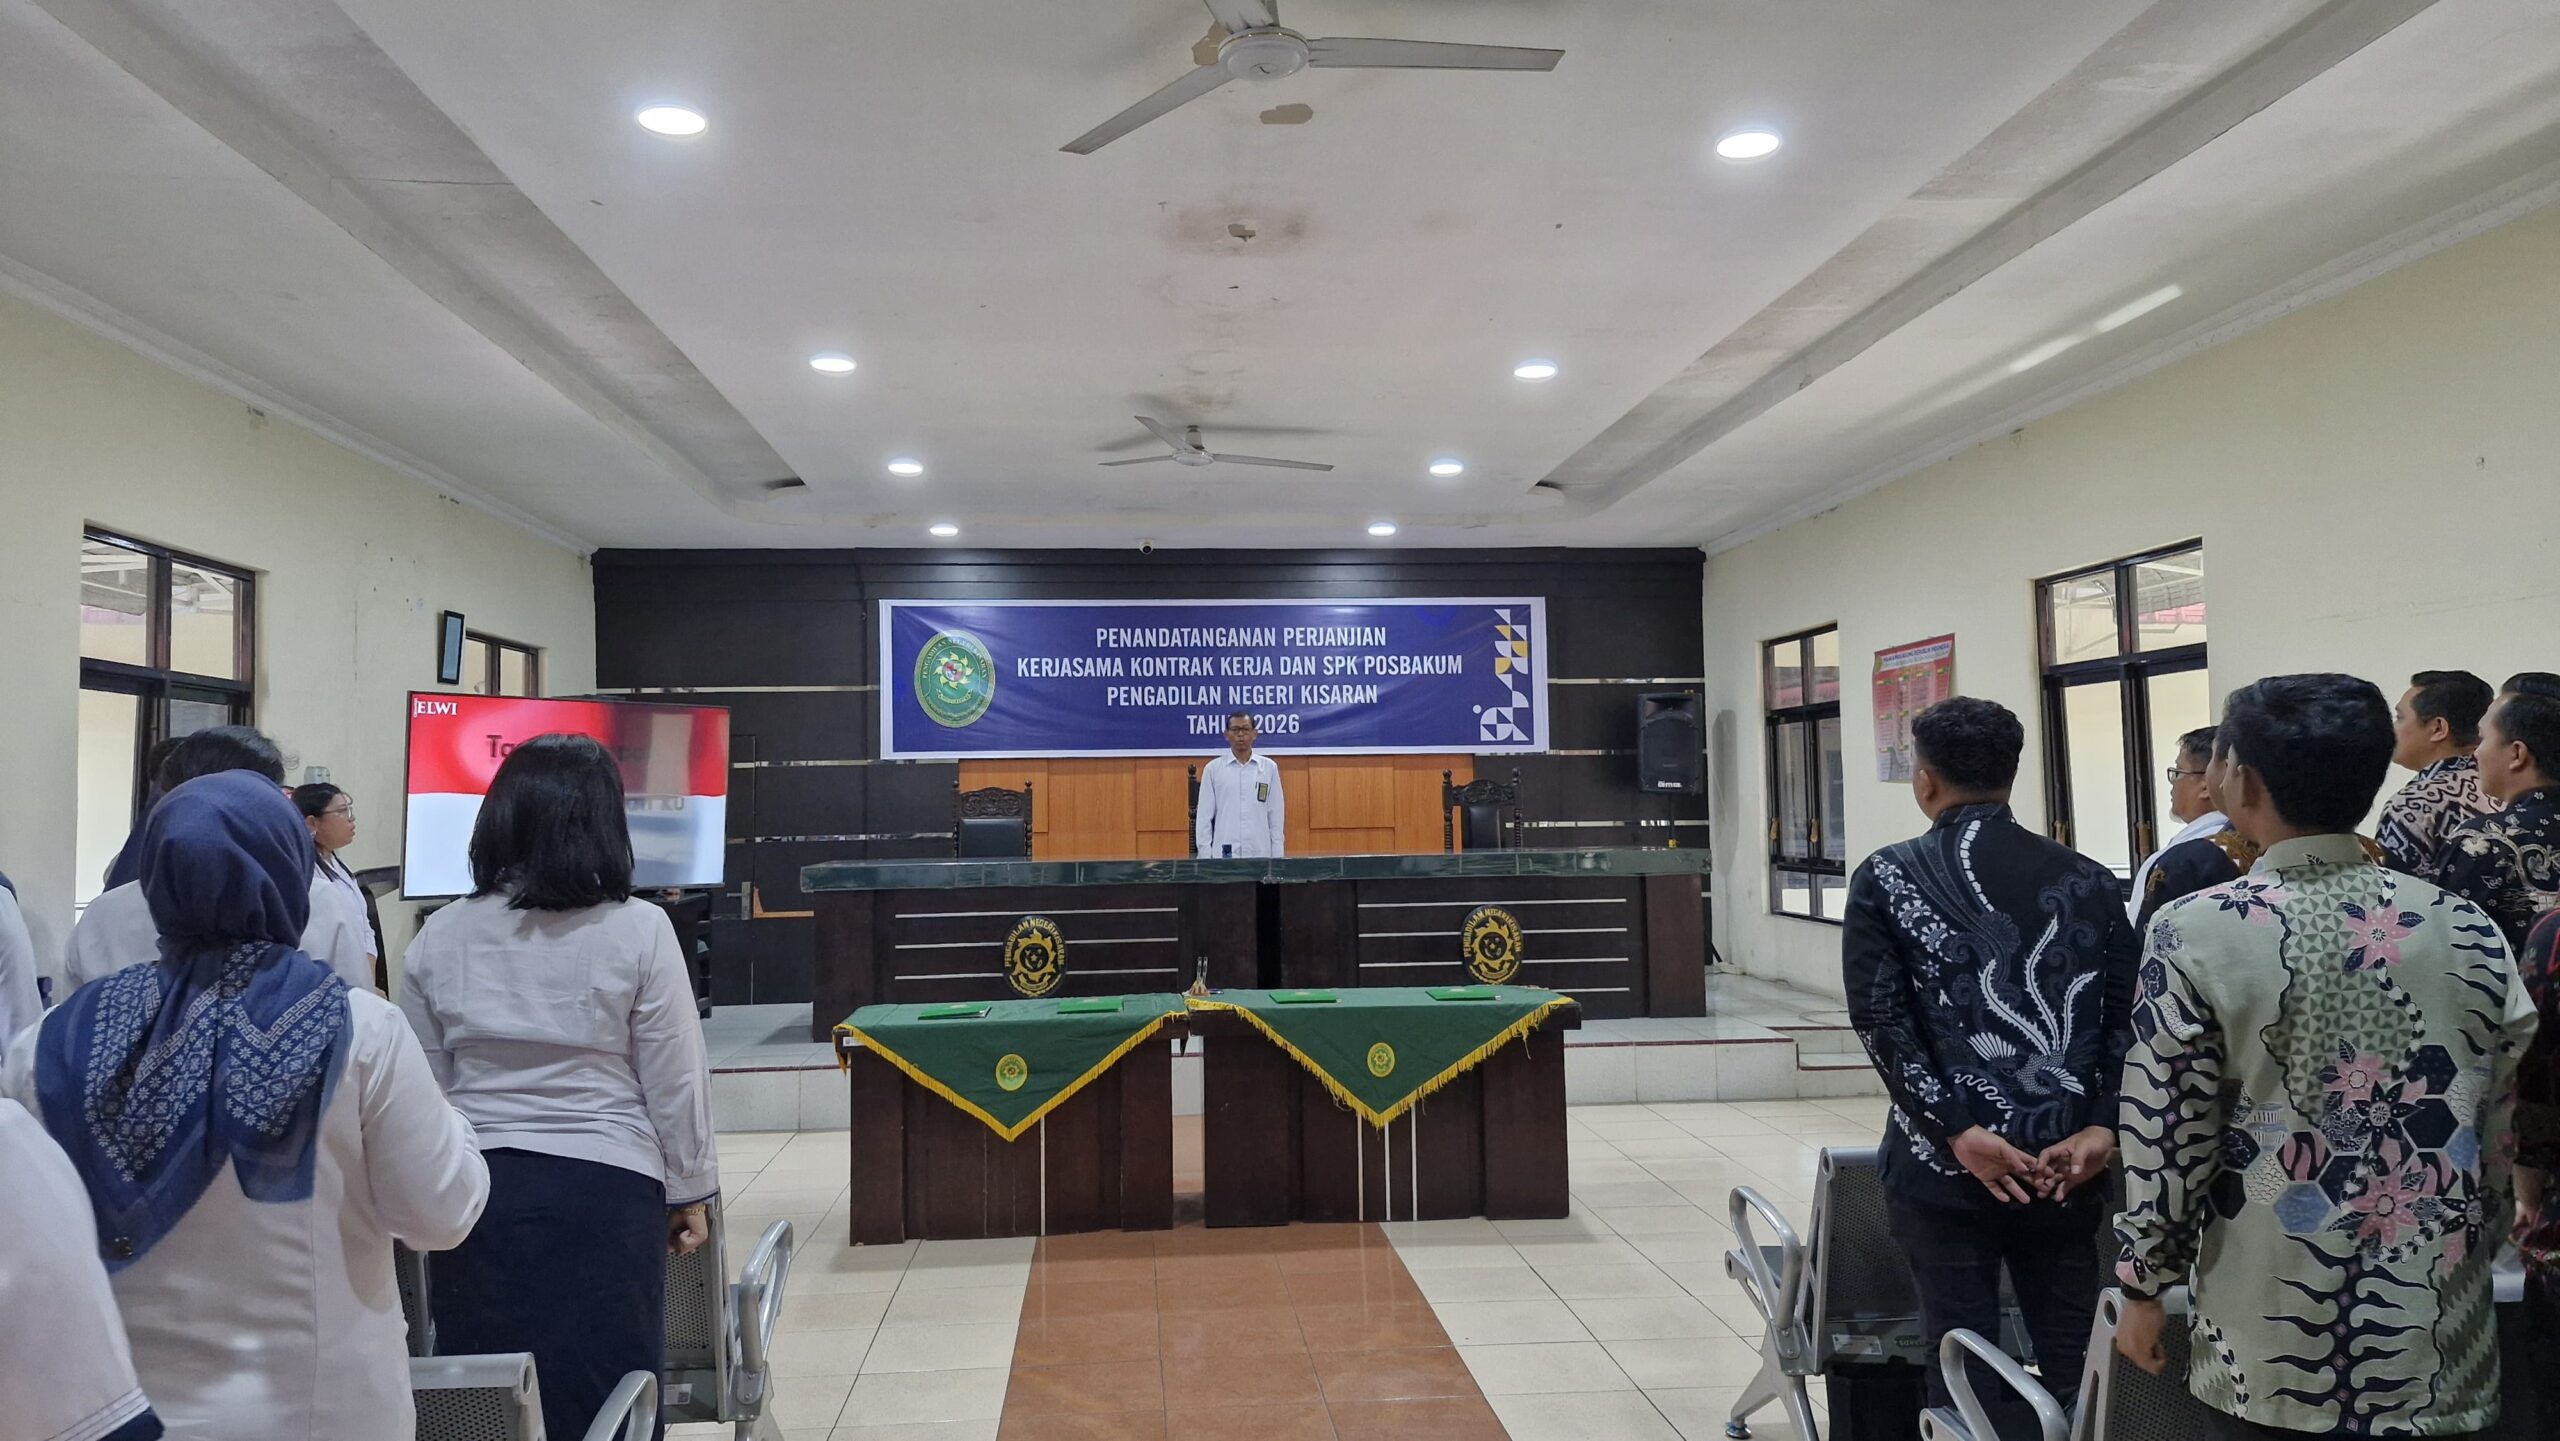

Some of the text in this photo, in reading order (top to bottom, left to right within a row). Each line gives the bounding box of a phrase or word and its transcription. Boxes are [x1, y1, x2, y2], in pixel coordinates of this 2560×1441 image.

[1096, 626, 1386, 648] PENANDATANGANAN PERJANJIAN
[1017, 655, 1462, 677] KERJASAMA KONTRAK KERJA DAN SPK POSBAKUM
[1107, 684, 1378, 706] PENGADILAN NEGERI KISARAN
[1187, 713, 1300, 734] TAHU 2026
